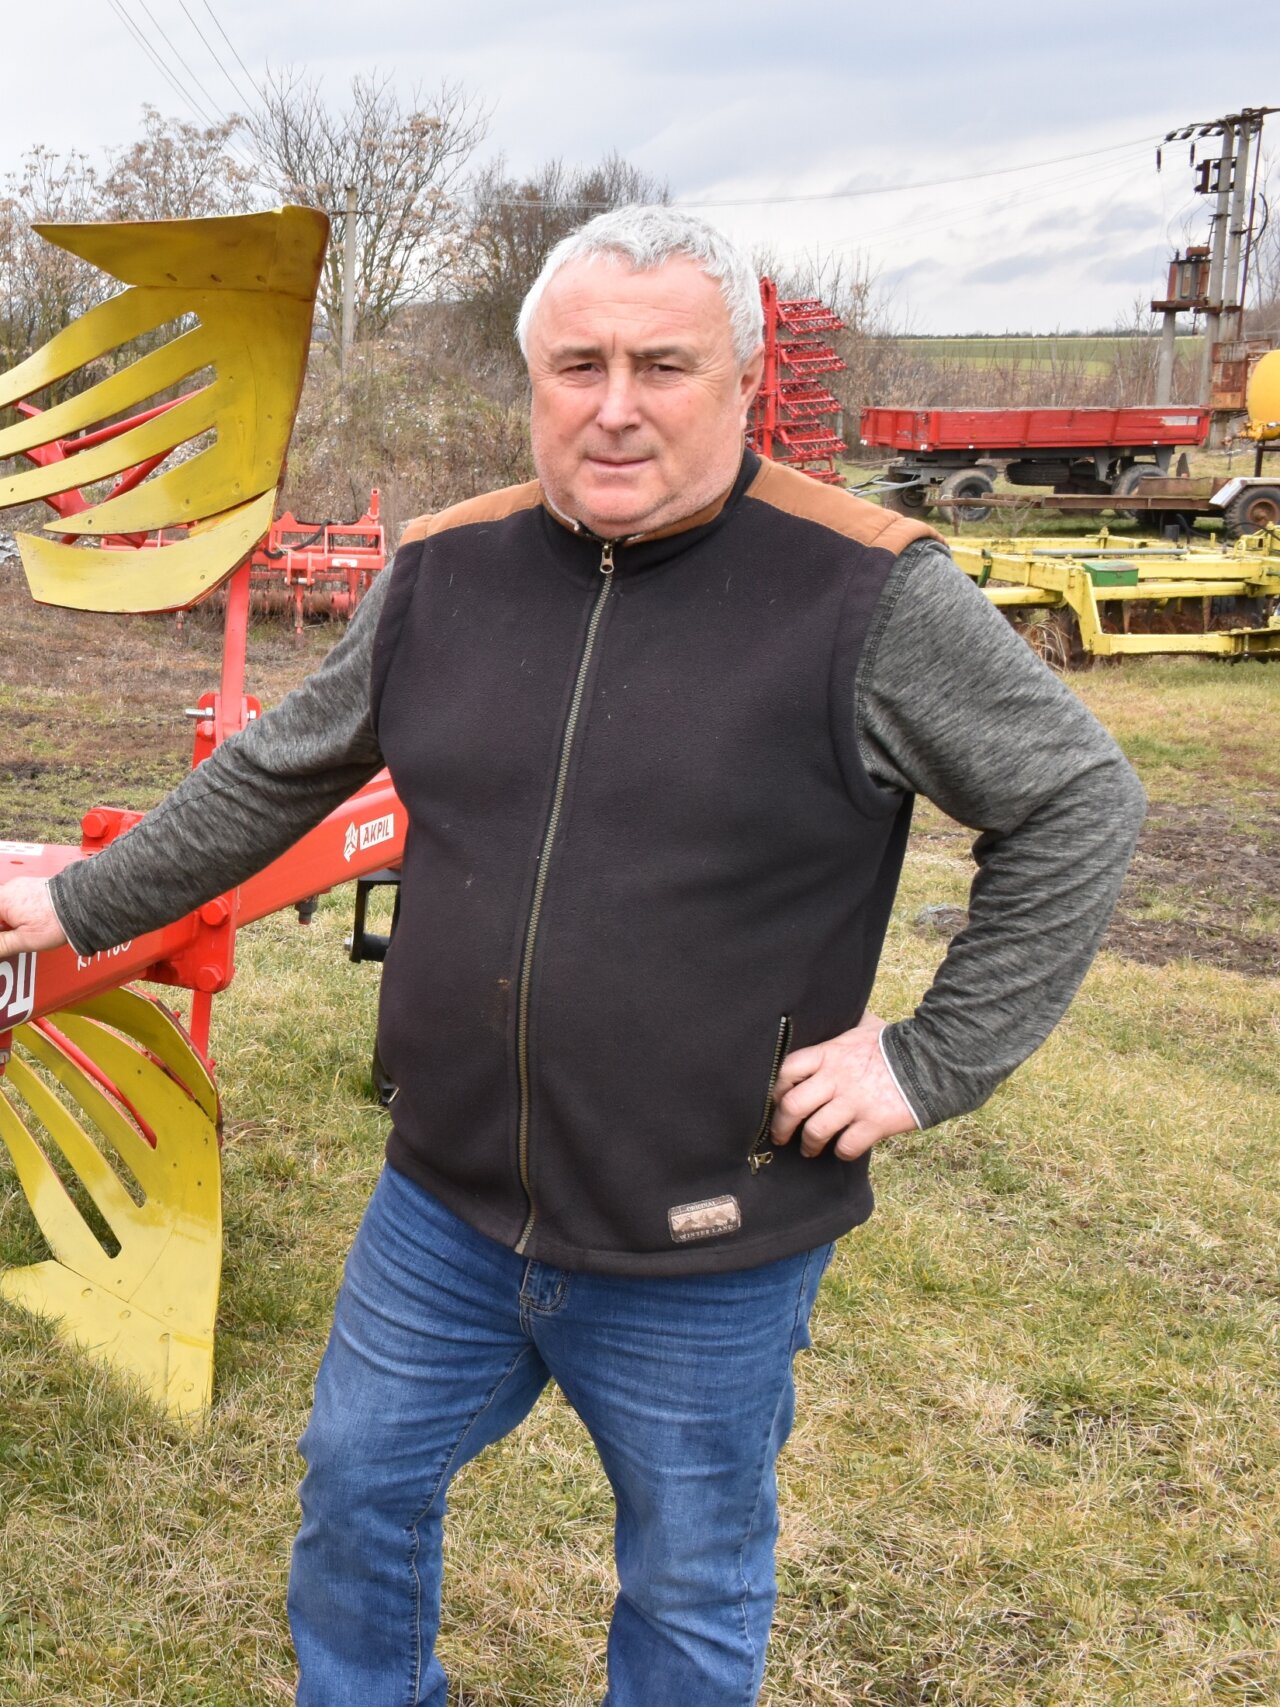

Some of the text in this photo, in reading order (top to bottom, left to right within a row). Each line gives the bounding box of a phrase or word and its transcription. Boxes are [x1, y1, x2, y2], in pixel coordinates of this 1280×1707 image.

[363, 818, 390, 846] AKPIL
[680, 1224, 734, 1240] WINTER LAND
